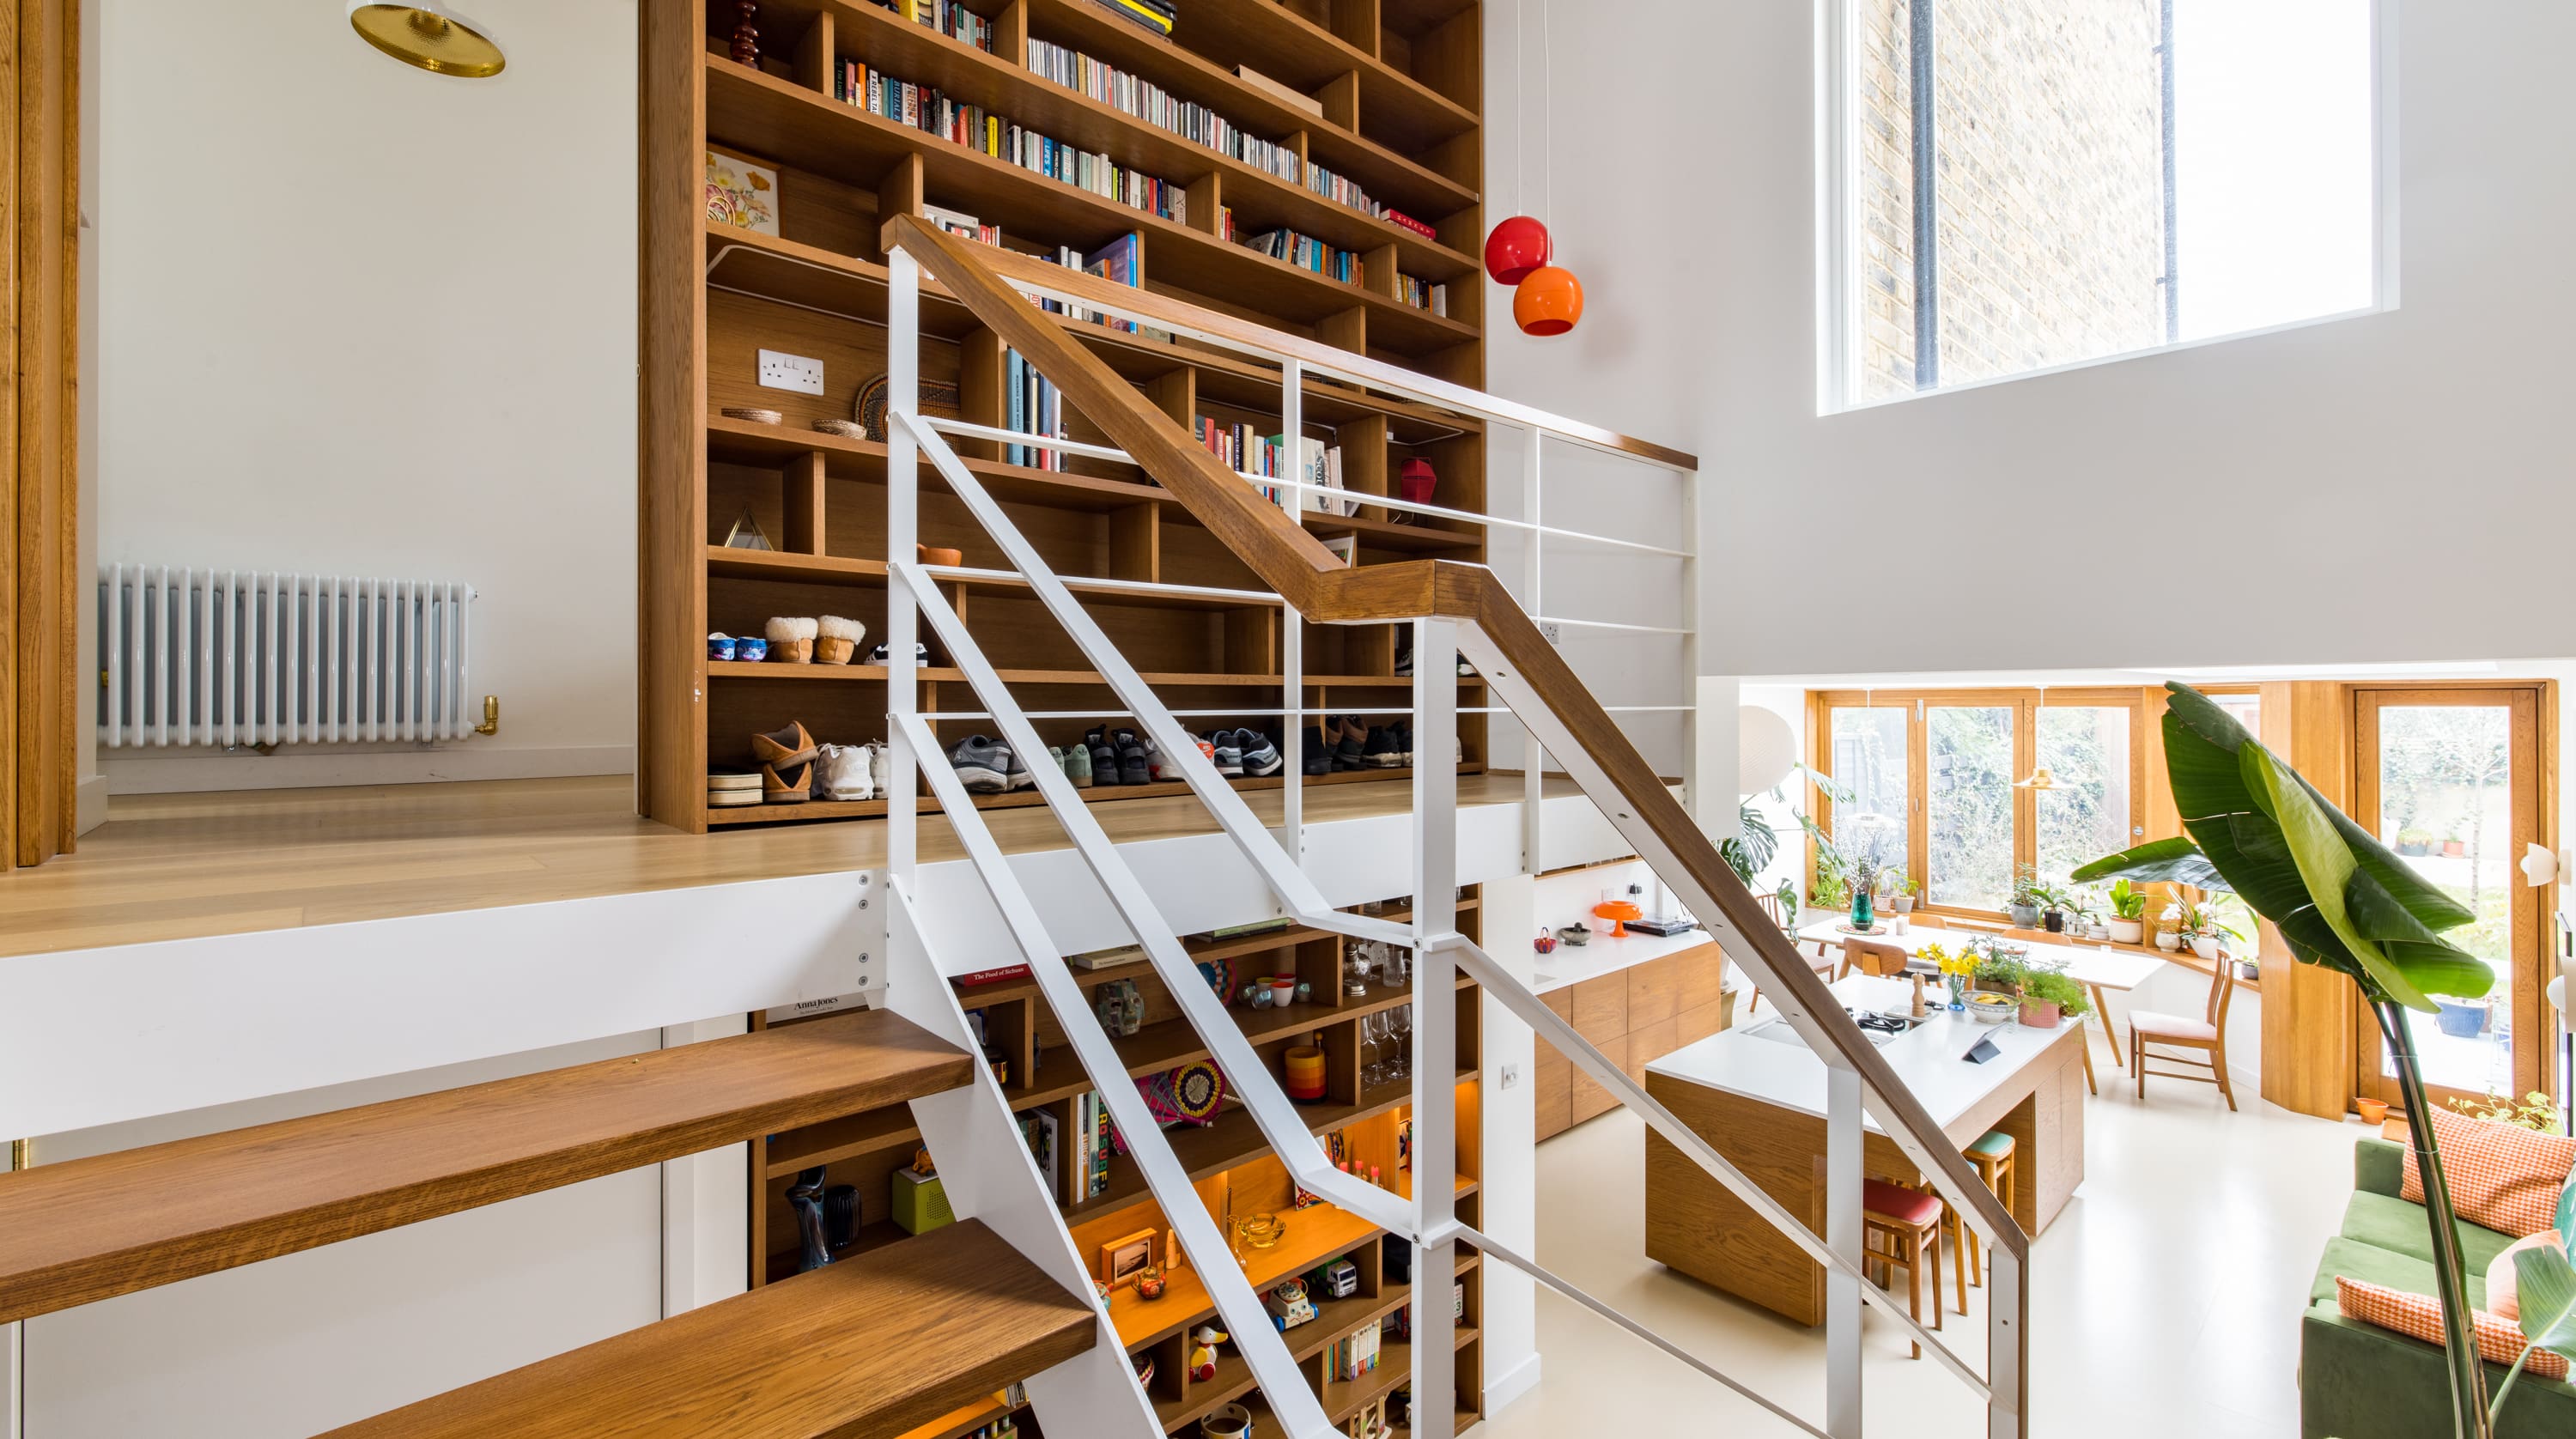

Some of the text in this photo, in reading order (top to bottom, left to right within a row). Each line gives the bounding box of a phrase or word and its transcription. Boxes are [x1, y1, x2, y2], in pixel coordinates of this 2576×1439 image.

[1004, 967, 1024, 975] Sichuan
[794, 1002, 816, 1011] Anna
[816, 996, 838, 1008] Jones
